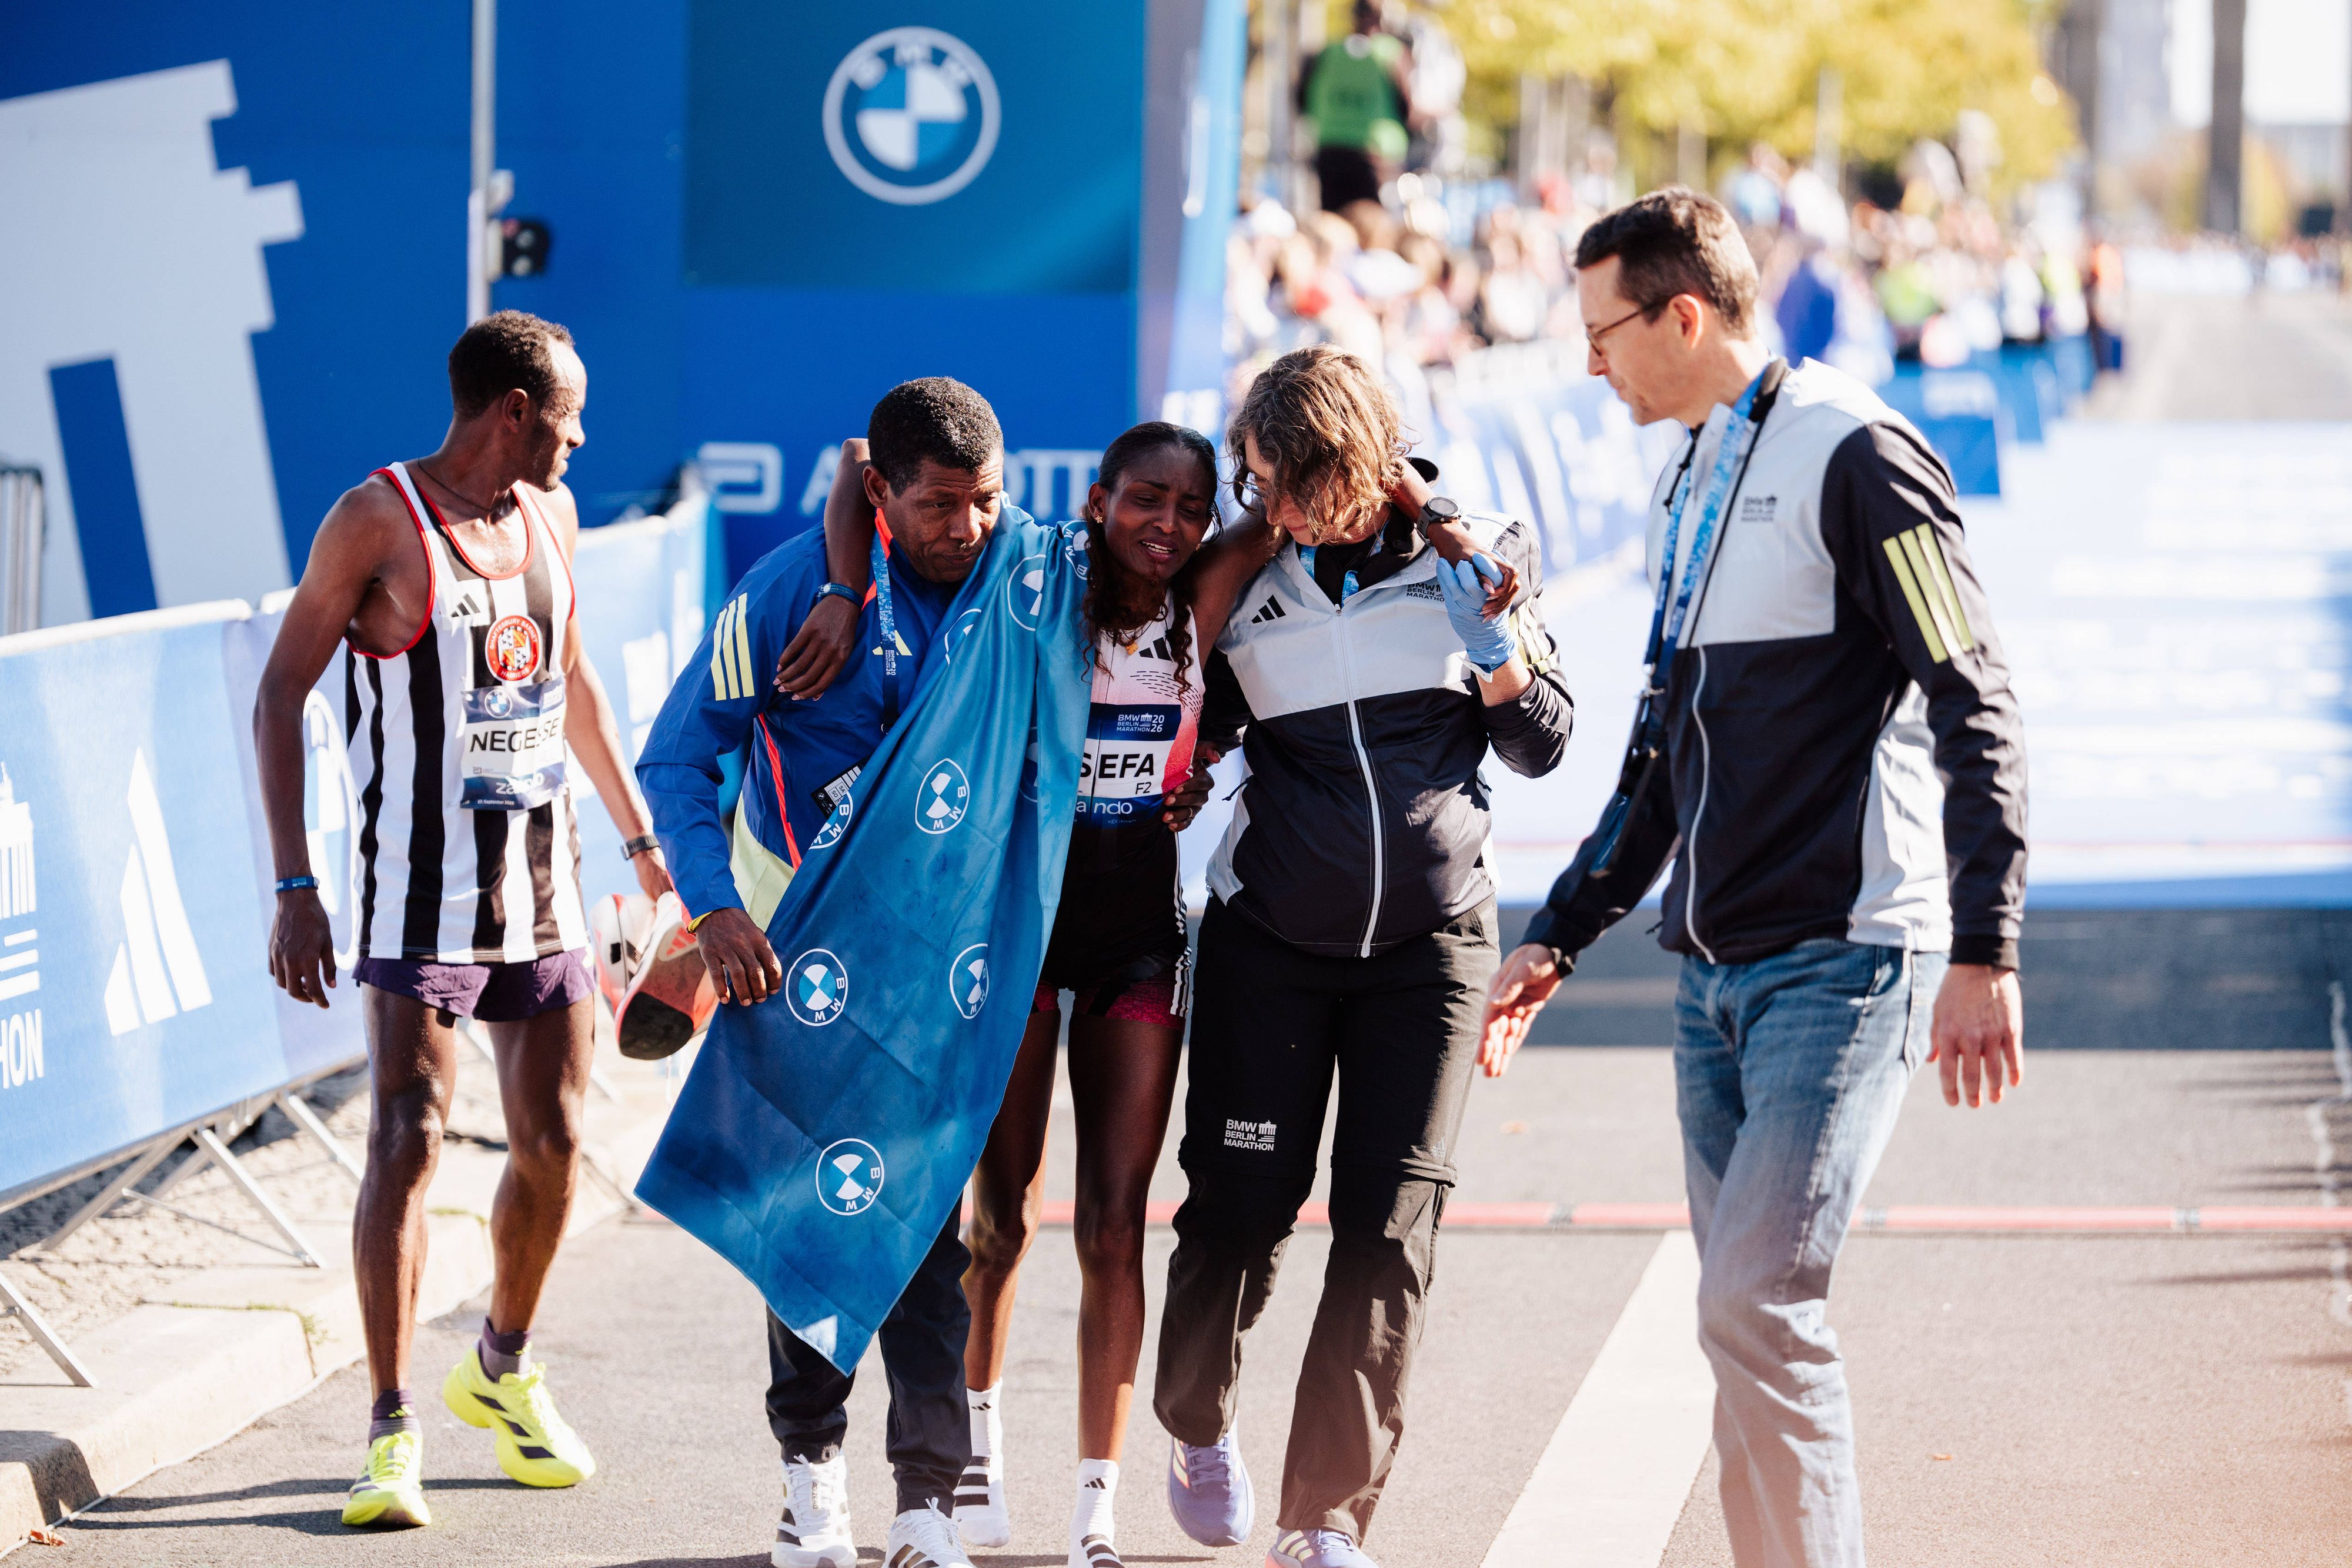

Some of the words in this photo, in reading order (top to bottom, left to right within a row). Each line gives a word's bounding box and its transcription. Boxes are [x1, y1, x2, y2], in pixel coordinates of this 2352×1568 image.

[1407, 588, 1435, 596] BERLIN
[1152, 714, 1165, 724] 20
[1150, 724, 1163, 733] 26
[831, 790, 838, 798] SO
[1135, 781, 1152, 795] F2
[933, 786, 967, 830] BMW
[815, 977, 845, 1022] BMW
[1226, 1119, 1257, 1132] BMW
[1225, 1130, 1256, 1141] BERLIN
[1224, 1138, 1274, 1151] MARATHON
[846, 1167, 881, 1212] BMW
